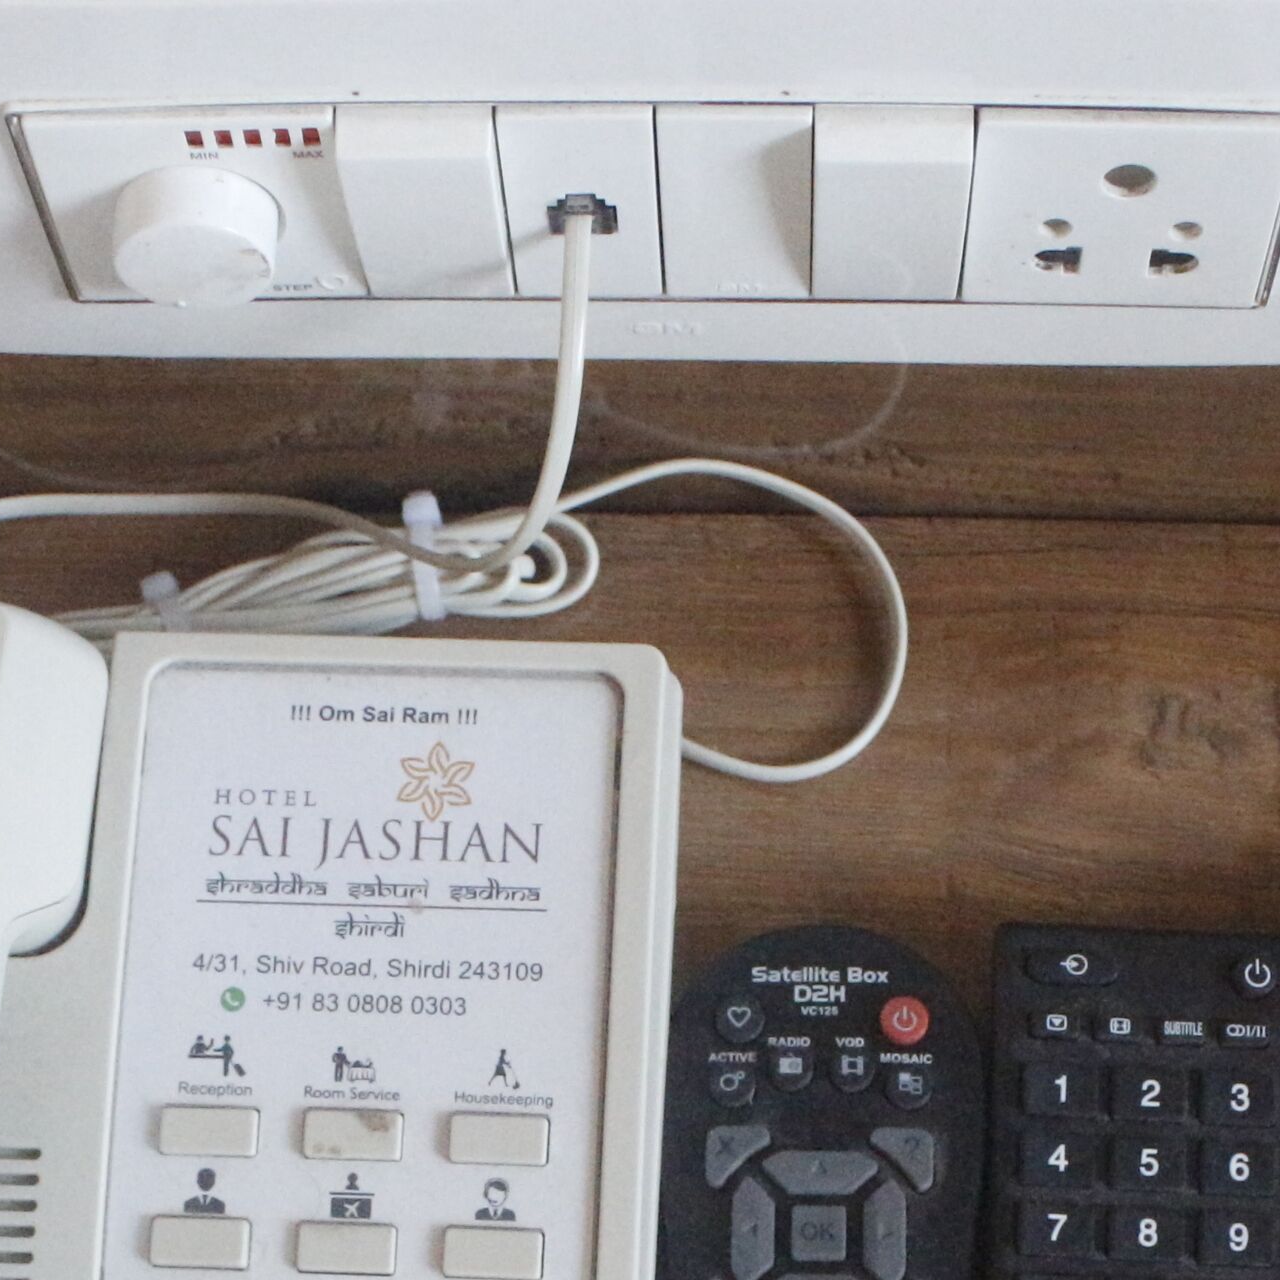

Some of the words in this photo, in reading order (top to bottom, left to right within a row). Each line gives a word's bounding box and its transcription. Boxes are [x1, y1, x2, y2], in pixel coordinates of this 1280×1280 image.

[190, 151, 219, 160] MIN
[293, 151, 324, 160] MAX
[320, 706, 354, 722] Om
[362, 706, 395, 723] Sai
[402, 708, 449, 724] Ram
[215, 789, 317, 807] HOTEL
[209, 814, 292, 858] SAI
[316, 818, 543, 870] JASHAN
[205, 872, 327, 896] shraddha
[347, 875, 429, 899] saburi
[450, 878, 540, 901] sadhna
[334, 912, 405, 938] shirdi
[193, 954, 247, 977] 4/31,
[256, 956, 303, 975] Shiv
[313, 957, 377, 979] Road,
[387, 959, 450, 979] Shirdi
[459, 961, 543, 981] 243109
[751, 966, 840, 983] Satellite
[847, 967, 889, 983] Box
[794, 985, 846, 1003] D2H
[262, 993, 302, 1011] +91
[312, 994, 338, 1013] 83
[348, 995, 402, 1014] 0808
[412, 996, 466, 1016] 0303
[1164, 1021, 1203, 1036] SUBTITLE
[768, 1036, 811, 1048] RADIO
[836, 1037, 865, 1048] VOD
[708, 1052, 757, 1063] ACTIVE
[880, 1053, 933, 1064] MOSAIC
[178, 1081, 252, 1096] Reception
[304, 1086, 343, 1100] Room
[351, 1087, 400, 1101] Service
[1054, 1075, 1067, 1103] 1
[1140, 1080, 1161, 1107] 2
[1230, 1083, 1250, 1112] 3
[454, 1091, 554, 1108] Housekeeping
[1048, 1144, 1069, 1172] 4
[1139, 1149, 1159, 1177] 5
[1229, 1153, 1250, 1181] 6
[800, 1222, 833, 1241] OK
[1047, 1214, 1068, 1241] 7
[1138, 1218, 1158, 1247] 8
[1229, 1223, 1249, 1251] 9
